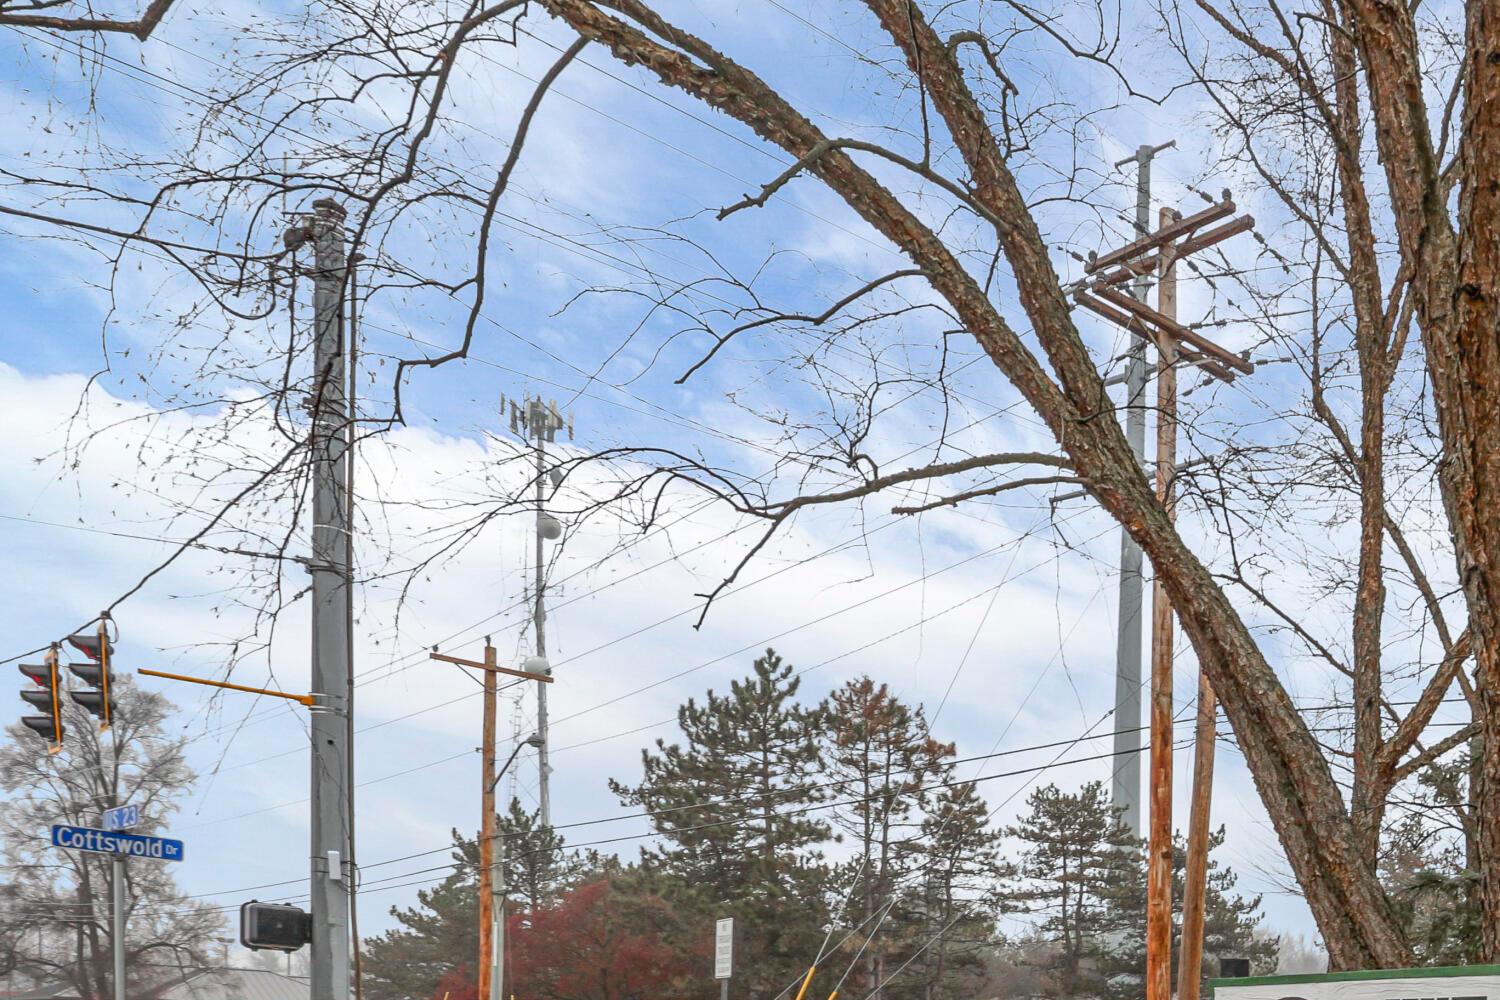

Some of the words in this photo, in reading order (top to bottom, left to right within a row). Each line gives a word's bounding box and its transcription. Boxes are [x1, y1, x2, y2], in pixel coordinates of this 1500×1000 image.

[122, 806, 137, 827] 23
[57, 827, 162, 857] Cottswold
[165, 844, 179, 855] Dr
